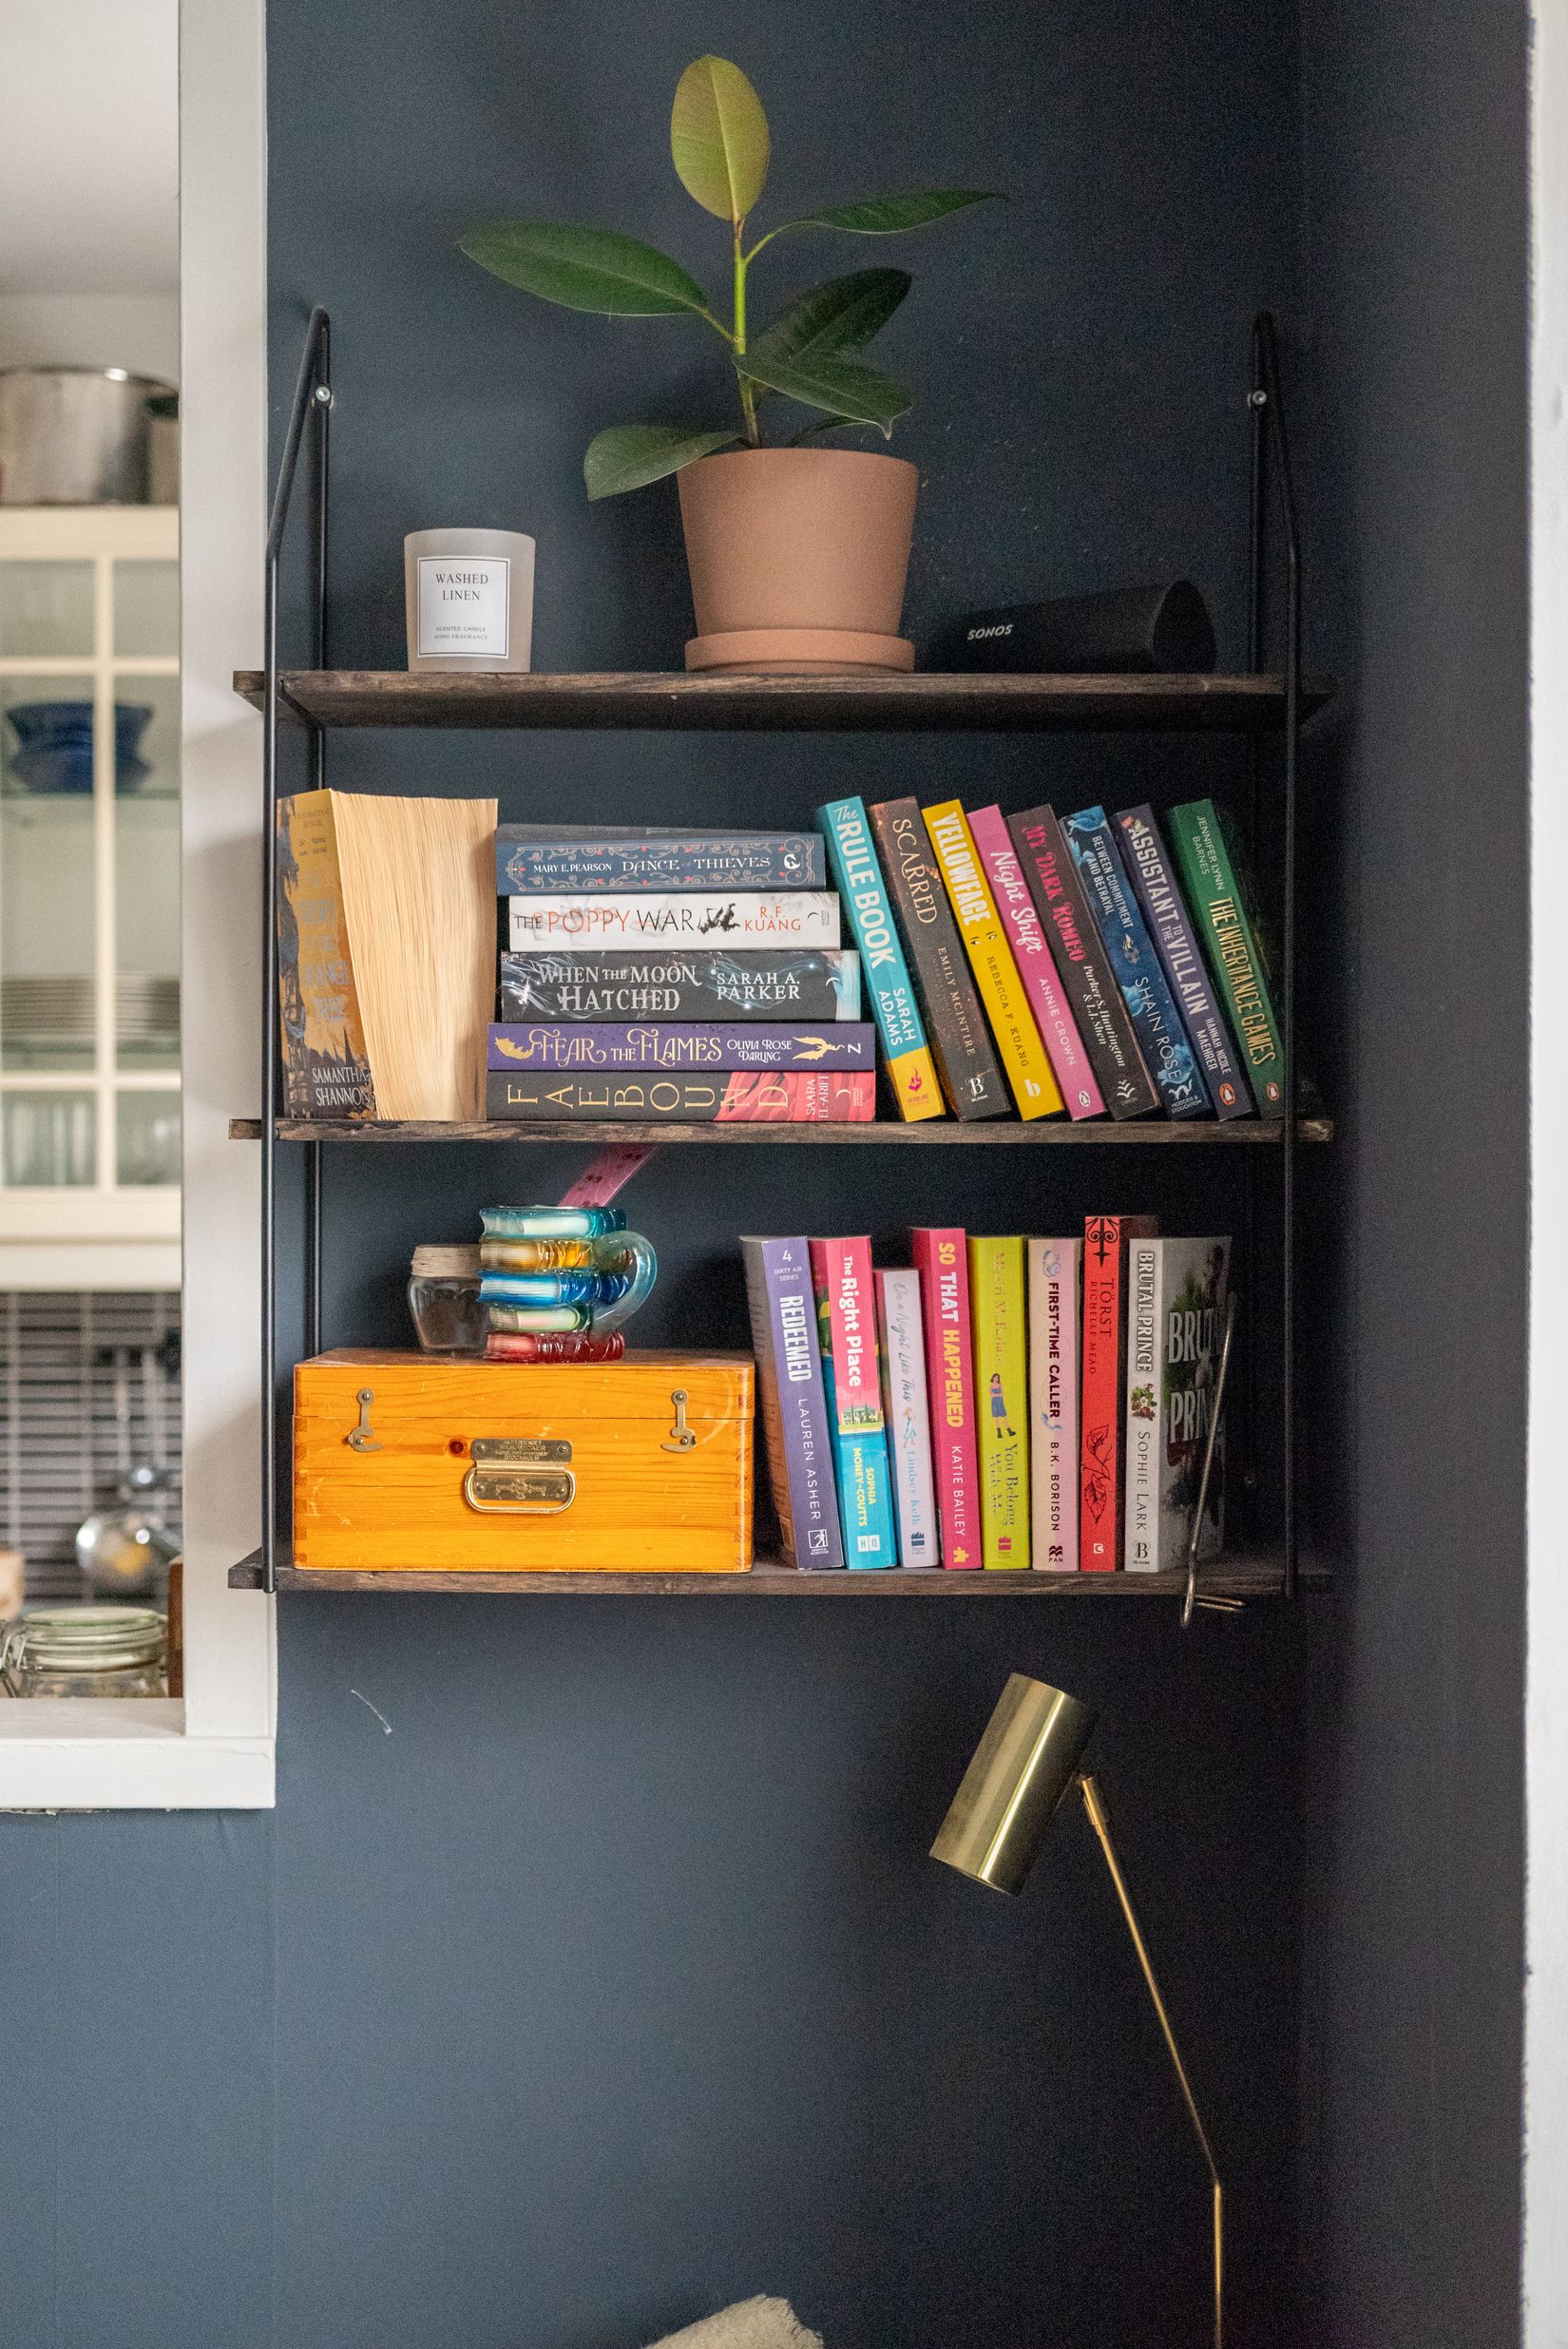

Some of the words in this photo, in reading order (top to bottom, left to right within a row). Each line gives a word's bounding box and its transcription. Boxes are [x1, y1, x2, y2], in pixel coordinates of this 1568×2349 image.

[435, 573, 489, 584] WASHED
[442, 590, 480, 601] LINEN
[967, 624, 1013, 640] SONOS
[834, 804, 859, 823] The
[533, 863, 559, 873] MARY
[561, 864, 570, 873] E.
[570, 862, 612, 872] PEARSON
[622, 859, 680, 874] DANCE
[694, 857, 771, 869] THIEVES
[836, 821, 876, 888] RULE
[893, 819, 938, 924] SCARRED
[932, 812, 991, 927] YELLOWFACE
[1192, 835, 1210, 875] BARNES
[1196, 815, 1217, 863] JENNIFER
[1211, 863, 1225, 891] LYNN
[990, 851, 1025, 904] Night
[1011, 907, 1042, 955] Shift
[1087, 858, 1101, 876] AND
[1094, 875, 1115, 916] BETRAYAL
[1092, 835, 1114, 874] BETWEEN
[1106, 872, 1134, 929] COMMITMENT
[1128, 826, 1180, 924] ASSISTANT
[1173, 924, 1184, 936] TO
[514, 914, 543, 930] THE
[548, 909, 630, 933] POPPY
[636, 909, 695, 932] WAR
[744, 918, 801, 932] KUANG
[760, 906, 773, 918] R.
[775, 906, 786, 917] F.
[854, 890, 897, 970] BOOK
[1052, 902, 1086, 962] ROMEO
[1161, 926, 1174, 942] THE
[538, 964, 599, 984] WHEN
[602, 968, 628, 980] THE
[630, 965, 702, 987] MOON
[717, 973, 777, 985] SARAH
[785, 972, 801, 985] A.
[717, 985, 801, 1000] PARKER
[1166, 936, 1209, 1016] VILLAIN
[1208, 896, 1238, 927] THE
[1240, 1012, 1276, 1066] GAMES
[557, 986, 680, 1012] HATCHED
[878, 991, 903, 1046] ADAMS
[893, 987, 917, 1041] SARAH
[938, 947, 956, 987] EMILY
[950, 991, 976, 1057] MCINTIRE
[987, 956, 1009, 1010] REBECCA
[1010, 1027, 1029, 1068] KUANG
[1084, 965, 1101, 1000] Parker
[1100, 1009, 1126, 1067] Huntington
[727, 1039, 759, 1050] OLIVIA
[761, 1039, 792, 1050] ROSE
[1039, 978, 1060, 1017] ANNIE
[1054, 1021, 1076, 1066] CROWN
[1093, 1021, 1106, 1046] Shen
[1135, 976, 1165, 1032] SHAIN
[1156, 1036, 1182, 1080] ROSE
[529, 1028, 607, 1068] FEAR
[611, 1048, 637, 1061] THE
[627, 1028, 722, 1068] FLAMES
[738, 1050, 781, 1063] DARLING
[1195, 1029, 1218, 1071] MAEHRER
[1205, 1017, 1222, 1049] HANNAH
[1216, 1049, 1232, 1075] NICOLE
[312, 1066, 367, 1083] SAMANTHA
[316, 1087, 370, 1106] SHANNON
[507, 1081, 788, 1112] FAEBOUND
[806, 1079, 816, 1116] SAARA
[1171, 1096, 1193, 1108] HODDER
[1171, 1098, 1202, 1114] STOUGHTON
[774, 1267, 787, 1275] DIRTY
[782, 1249, 793, 1262] 4
[843, 1256, 853, 1276] The
[938, 1242, 956, 1265] SO
[939, 1271, 959, 1323] THAT
[1138, 1251, 1155, 1312] BRUTAL
[839, 1278, 860, 1332] Right
[1048, 1282, 1060, 1359] FIRST-TIME
[1090, 1281, 1100, 1339] RICHELLE
[779, 1295, 813, 1382] REDEEMED
[1137, 1314, 1155, 1372] PRINCE
[846, 1336, 864, 1388] Place
[942, 1329, 965, 1428] HAPPENED
[1049, 1364, 1061, 1418] CALLER
[797, 1398, 814, 1461] LAUREN
[806, 1469, 822, 1520] ASHER
[907, 1451, 919, 1496] Lindsey
[951, 1445, 964, 1484] KATIE
[1004, 1443, 1018, 1471] You
[1050, 1442, 1060, 1467] B.K.
[1138, 1432, 1150, 1485] SOPHIE
[853, 1447, 868, 1527] MONEY-COUTTS
[866, 1467, 877, 1505] SOPHIA
[1004, 1476, 1019, 1526] Belong
[1050, 1474, 1061, 1531] BORISON
[909, 1499, 921, 1526] Kelk
[953, 1490, 966, 1536] BAILEY
[1136, 1493, 1149, 1530] LARK
